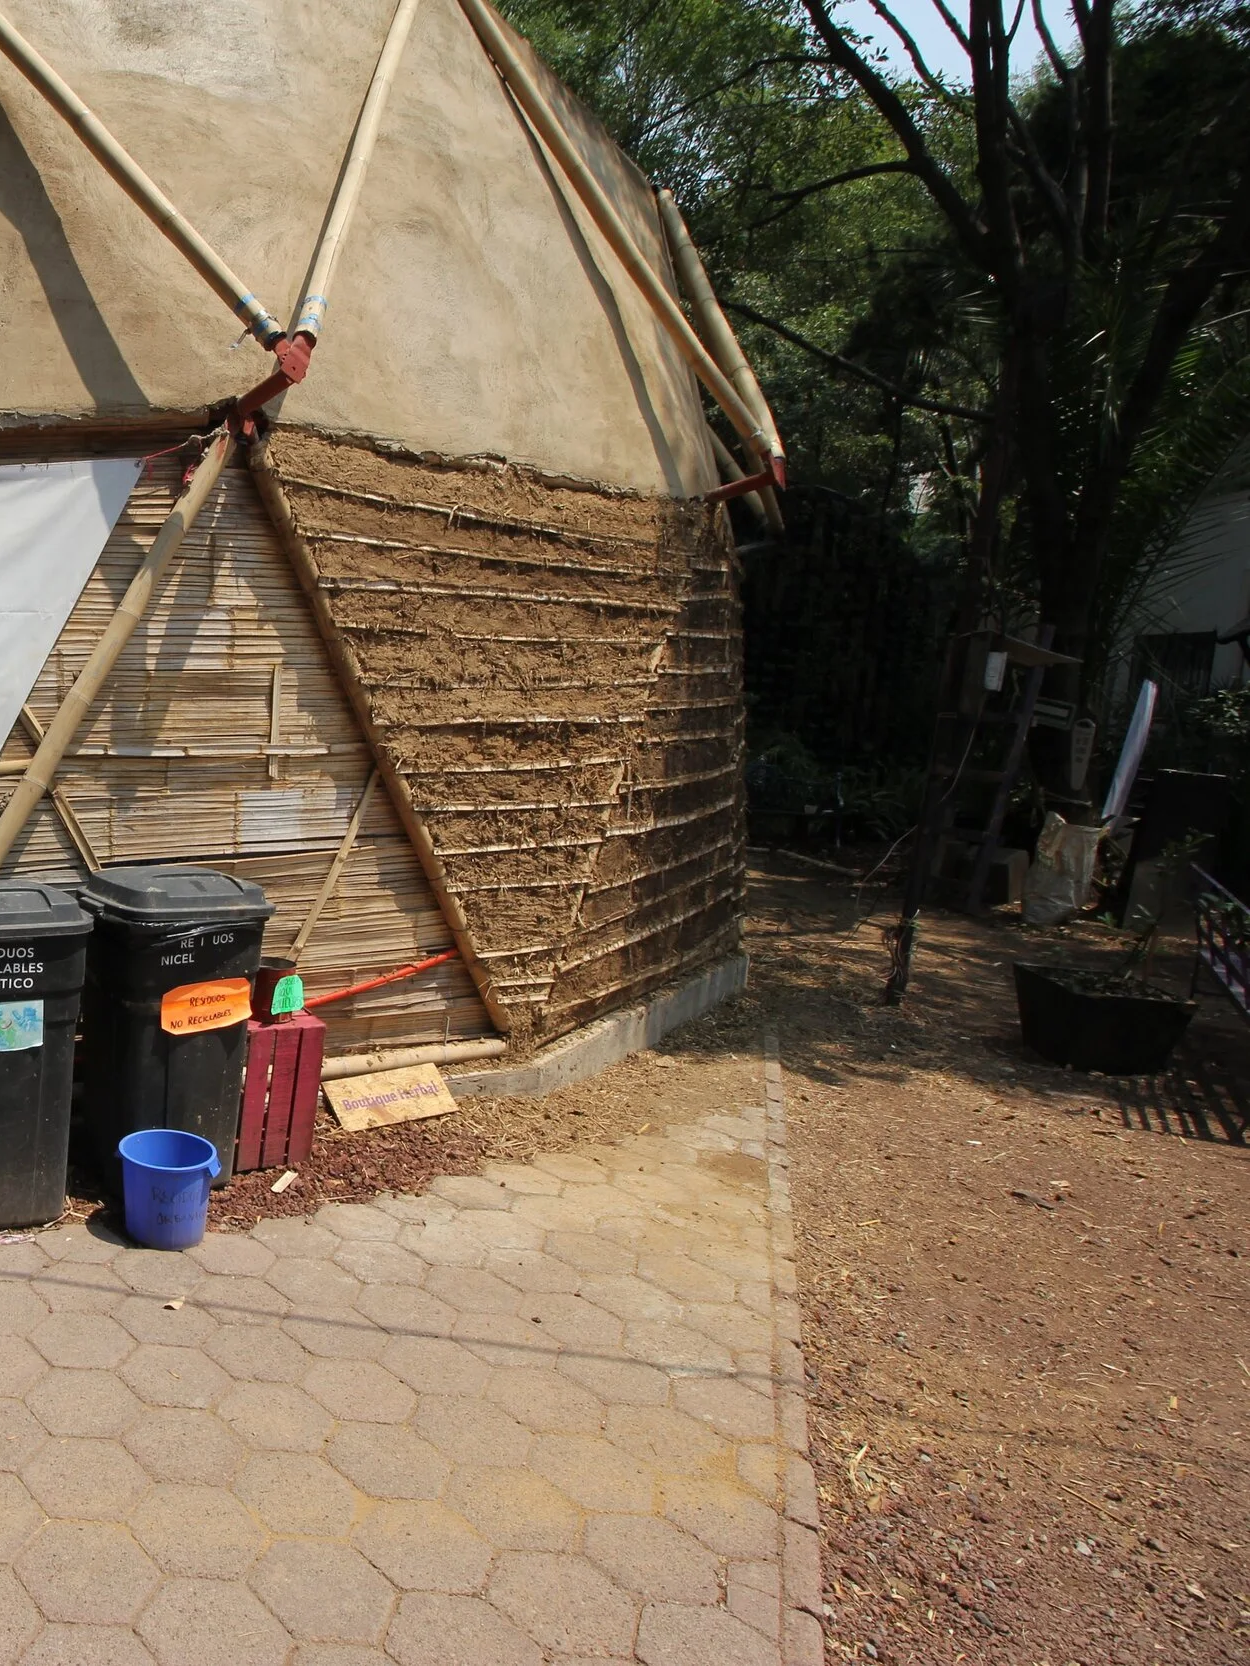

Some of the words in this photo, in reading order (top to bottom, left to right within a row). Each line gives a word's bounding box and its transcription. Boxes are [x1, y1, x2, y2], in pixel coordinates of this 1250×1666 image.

[170, 1020, 183, 1029] NO
[342, 1092, 398, 1111] Boutique
[398, 1080, 439, 1100] Herbal
